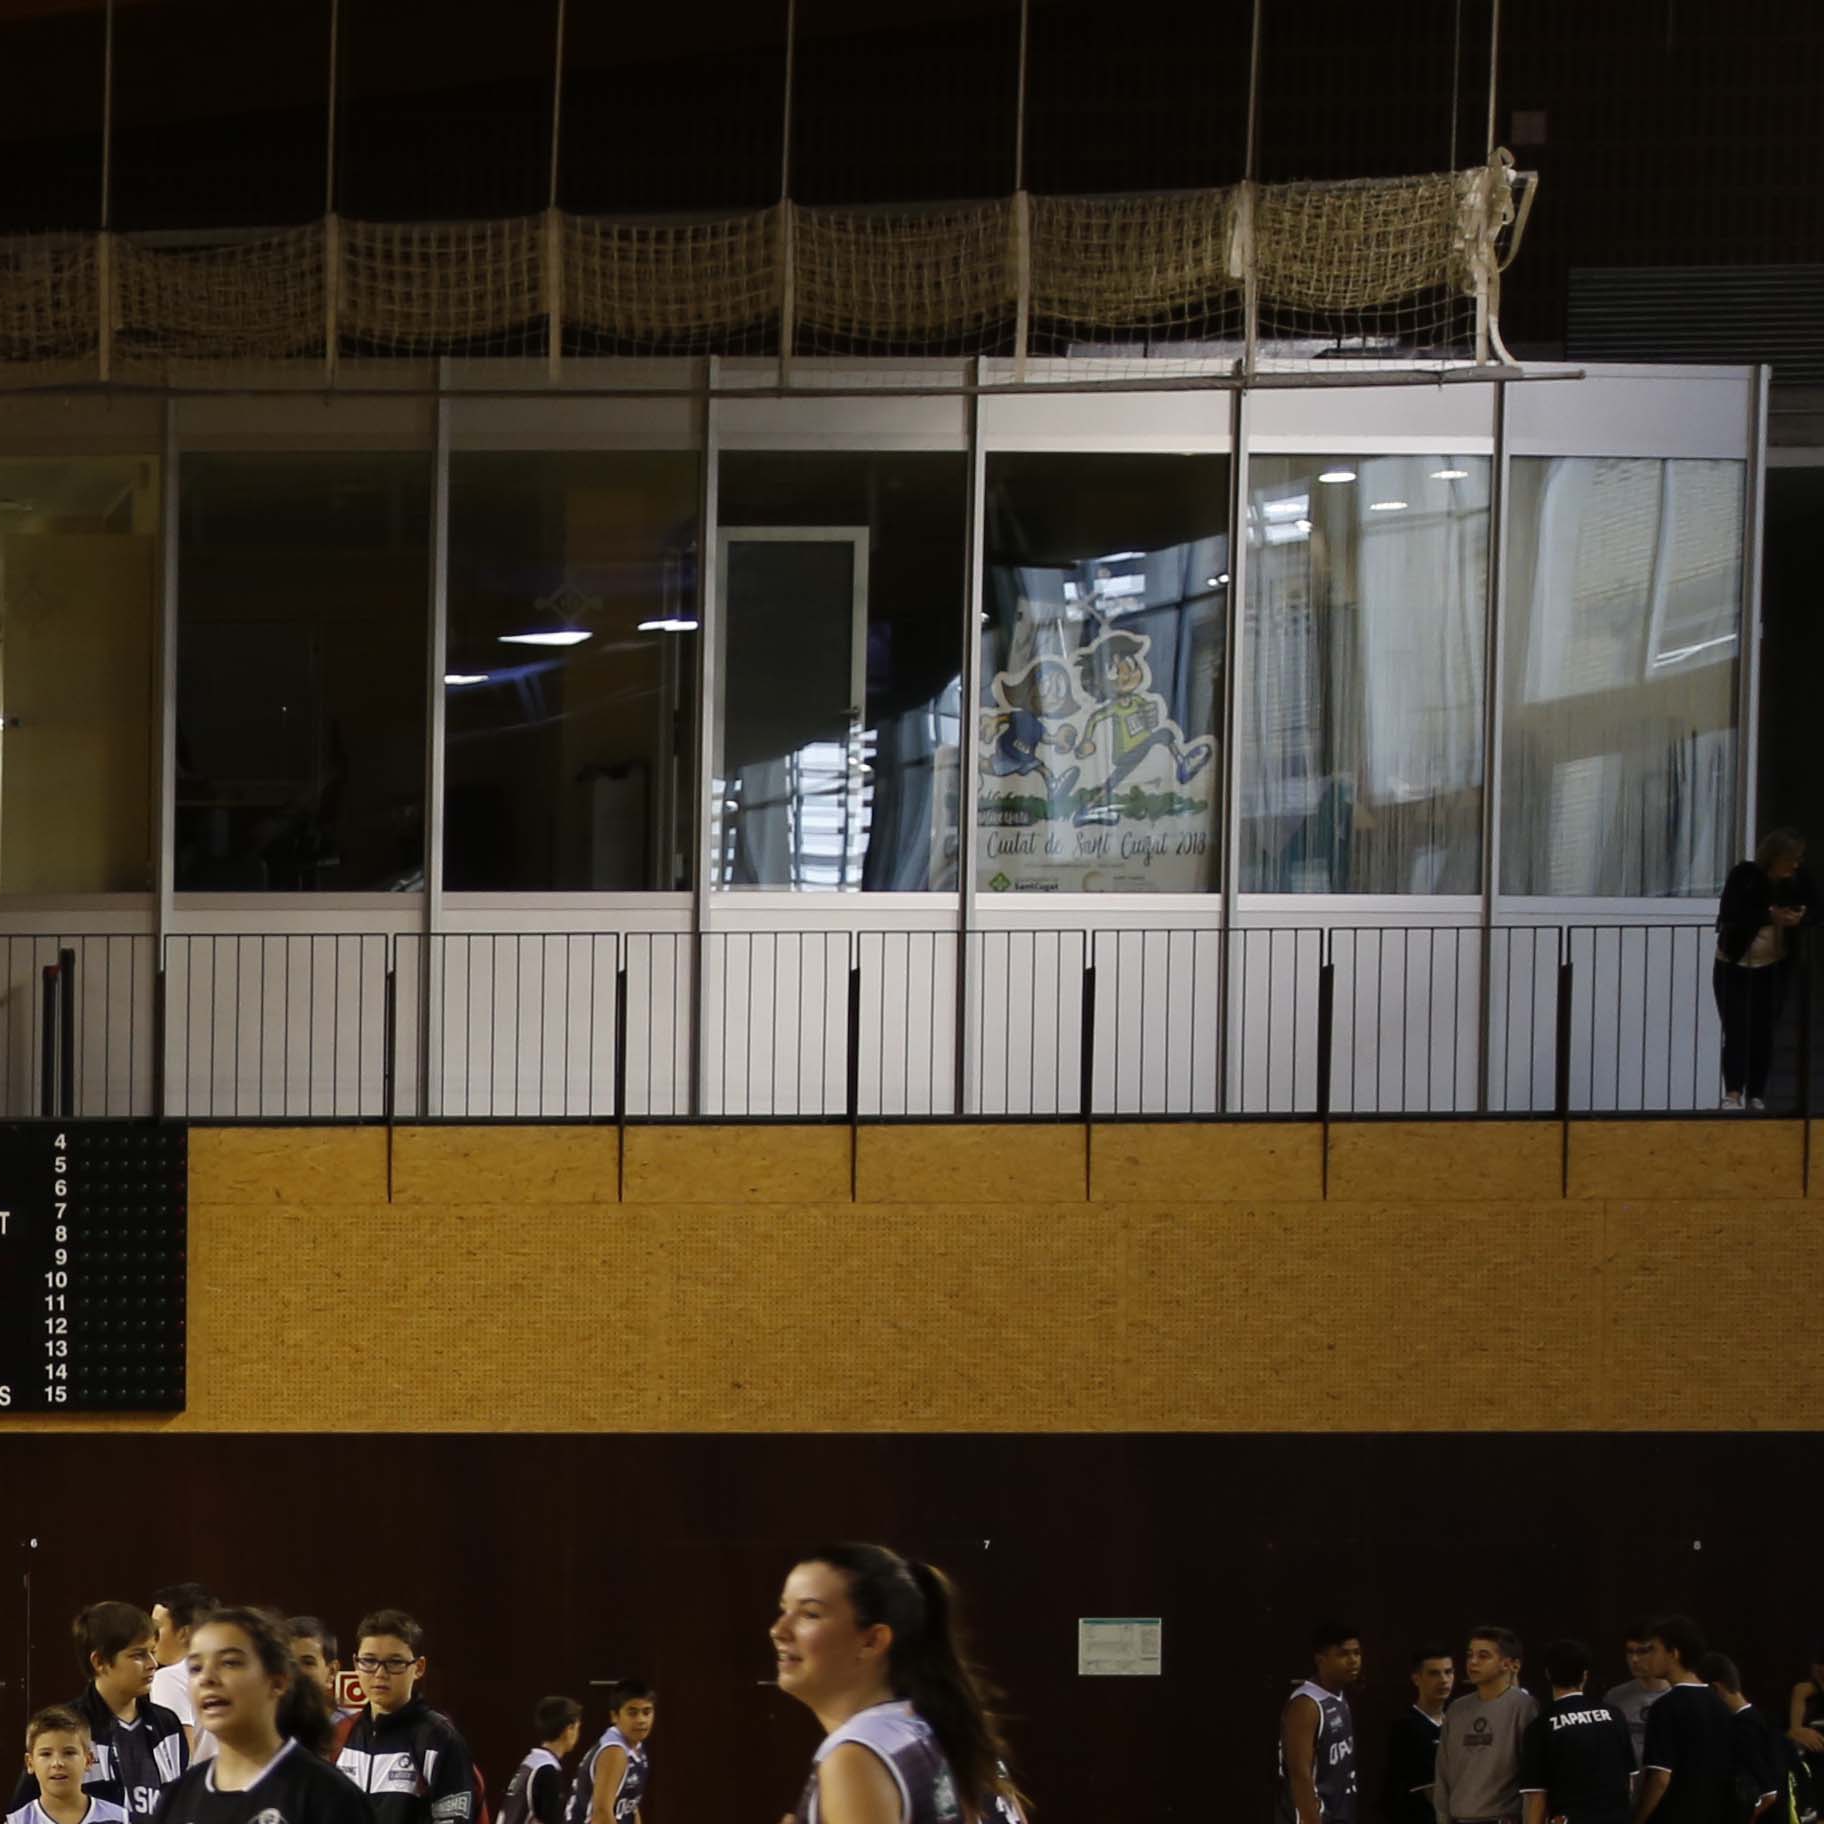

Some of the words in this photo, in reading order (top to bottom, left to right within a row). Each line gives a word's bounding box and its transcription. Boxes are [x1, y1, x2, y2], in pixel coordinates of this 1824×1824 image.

[55, 1134, 66, 1149] 4
[55, 1157, 66, 1172] 5
[55, 1180, 66, 1196] 6
[55, 1203, 66, 1219] 7
[55, 1226, 67, 1242] 8
[55, 1249, 67, 1265] 9
[45, 1272, 67, 1288] 10
[45, 1295, 65, 1311] 11
[45, 1318, 67, 1334] 12
[45, 1340, 67, 1357] 13
[45, 1364, 67, 1379] 14
[45, 1386, 67, 1402] 15
[1550, 1709, 1612, 1730] ZAPATER
